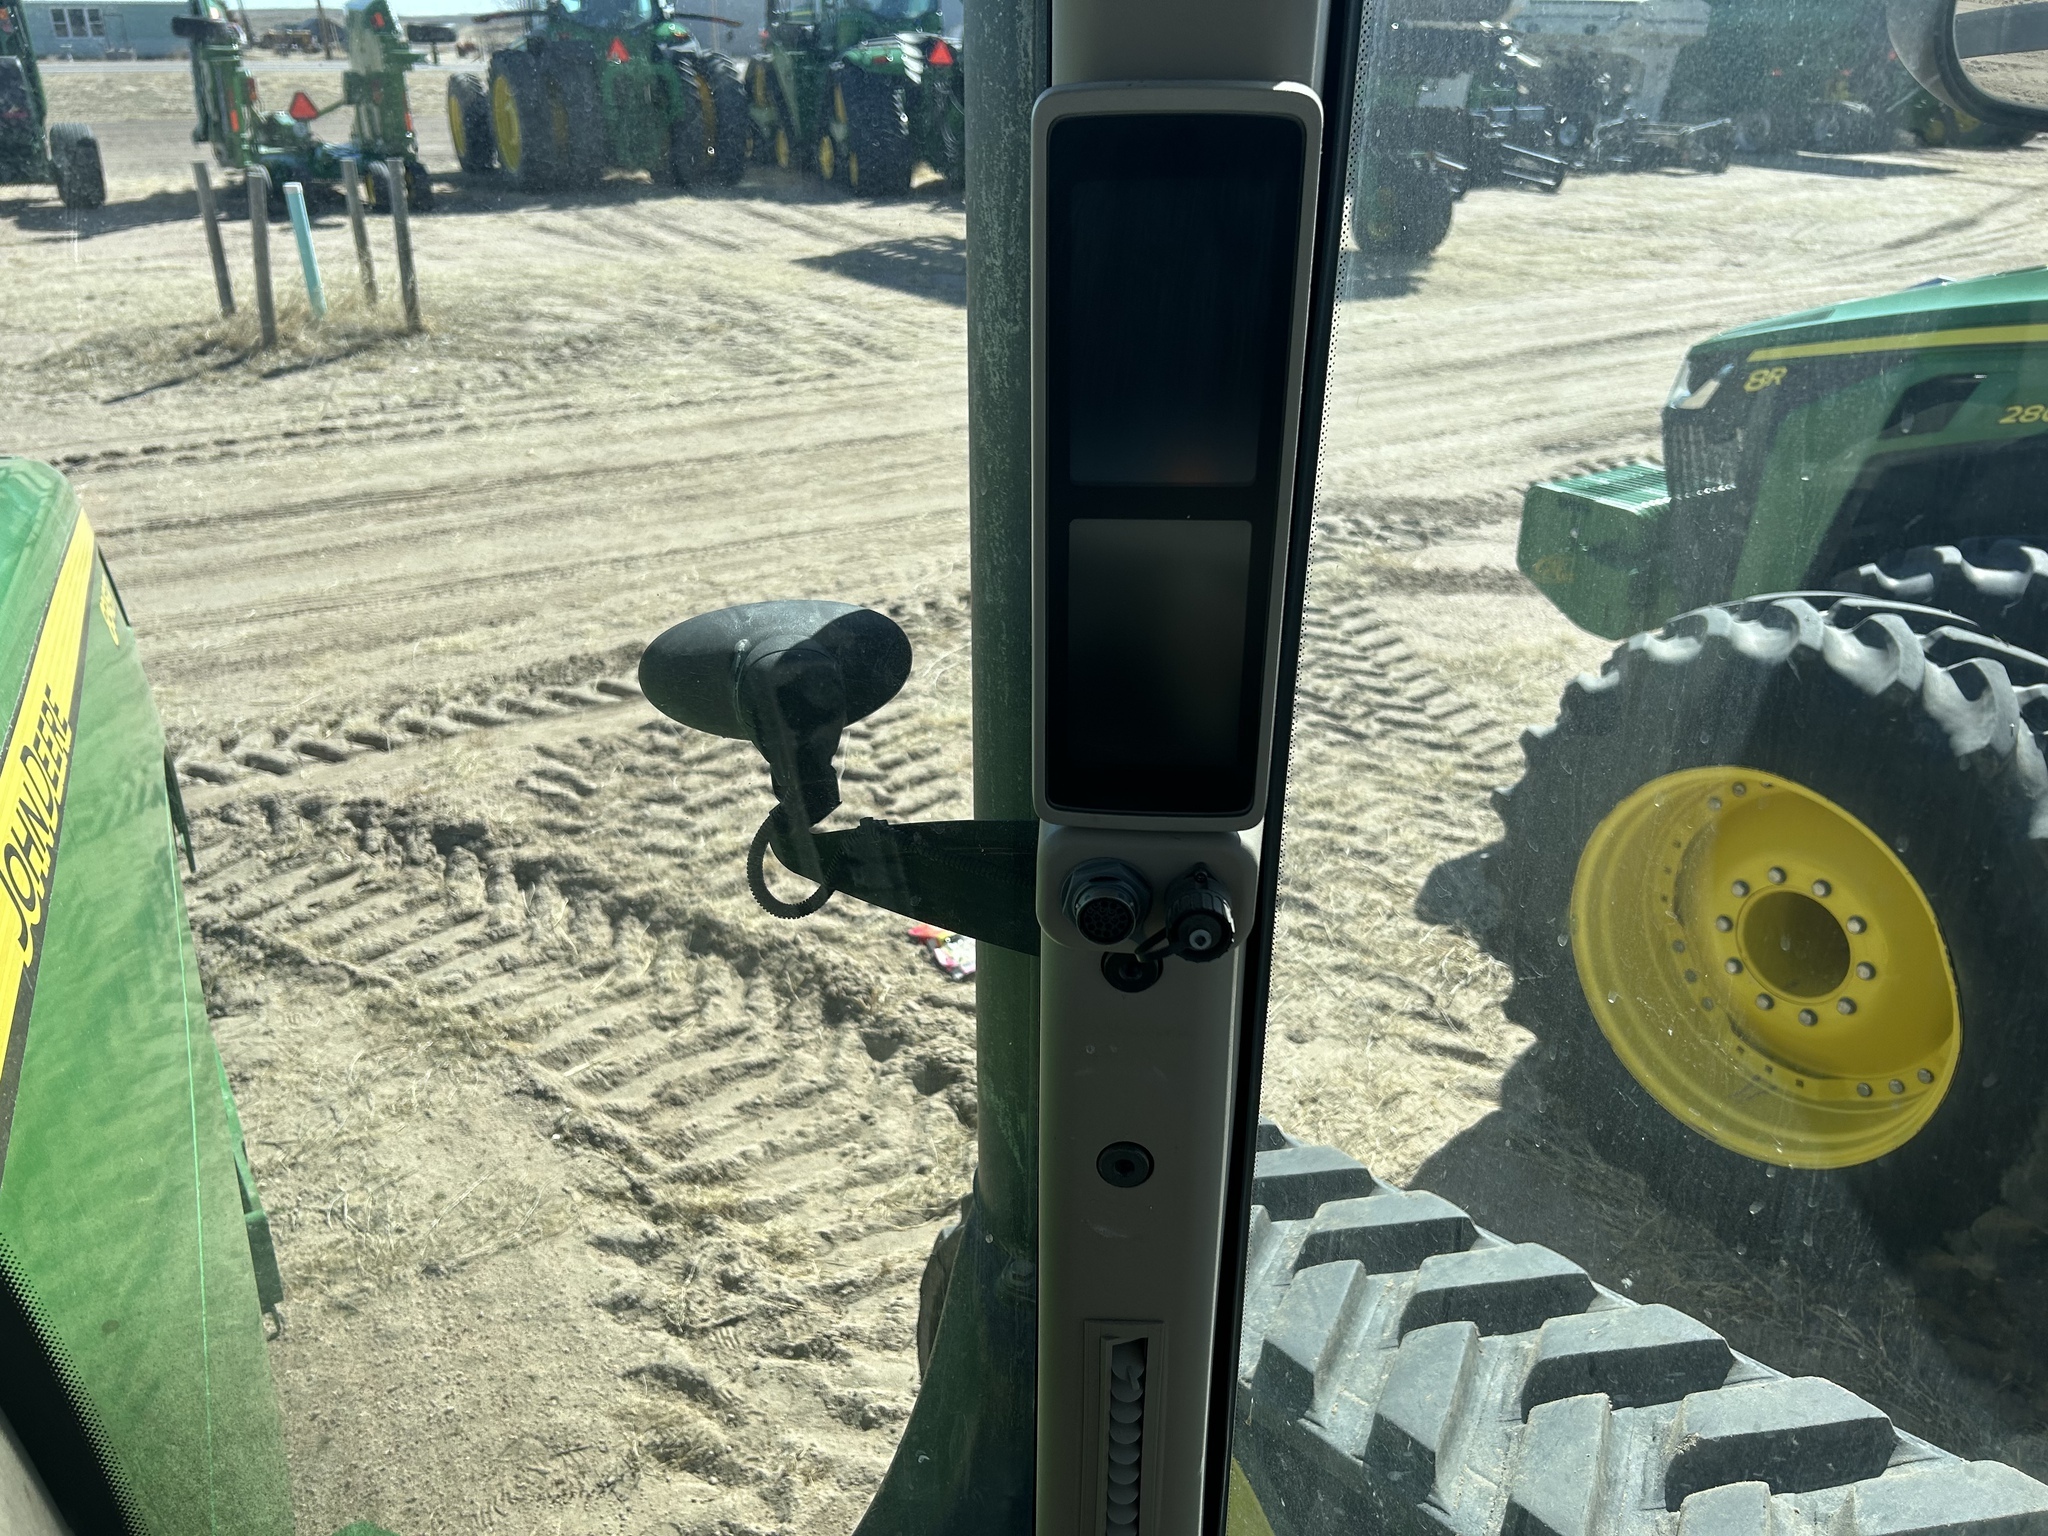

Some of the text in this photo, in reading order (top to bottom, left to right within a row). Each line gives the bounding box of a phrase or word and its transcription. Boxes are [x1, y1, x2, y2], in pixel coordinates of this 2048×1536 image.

[1743, 366, 1788, 393] 8R
[0, 682, 69, 953] JOHN DEERE
